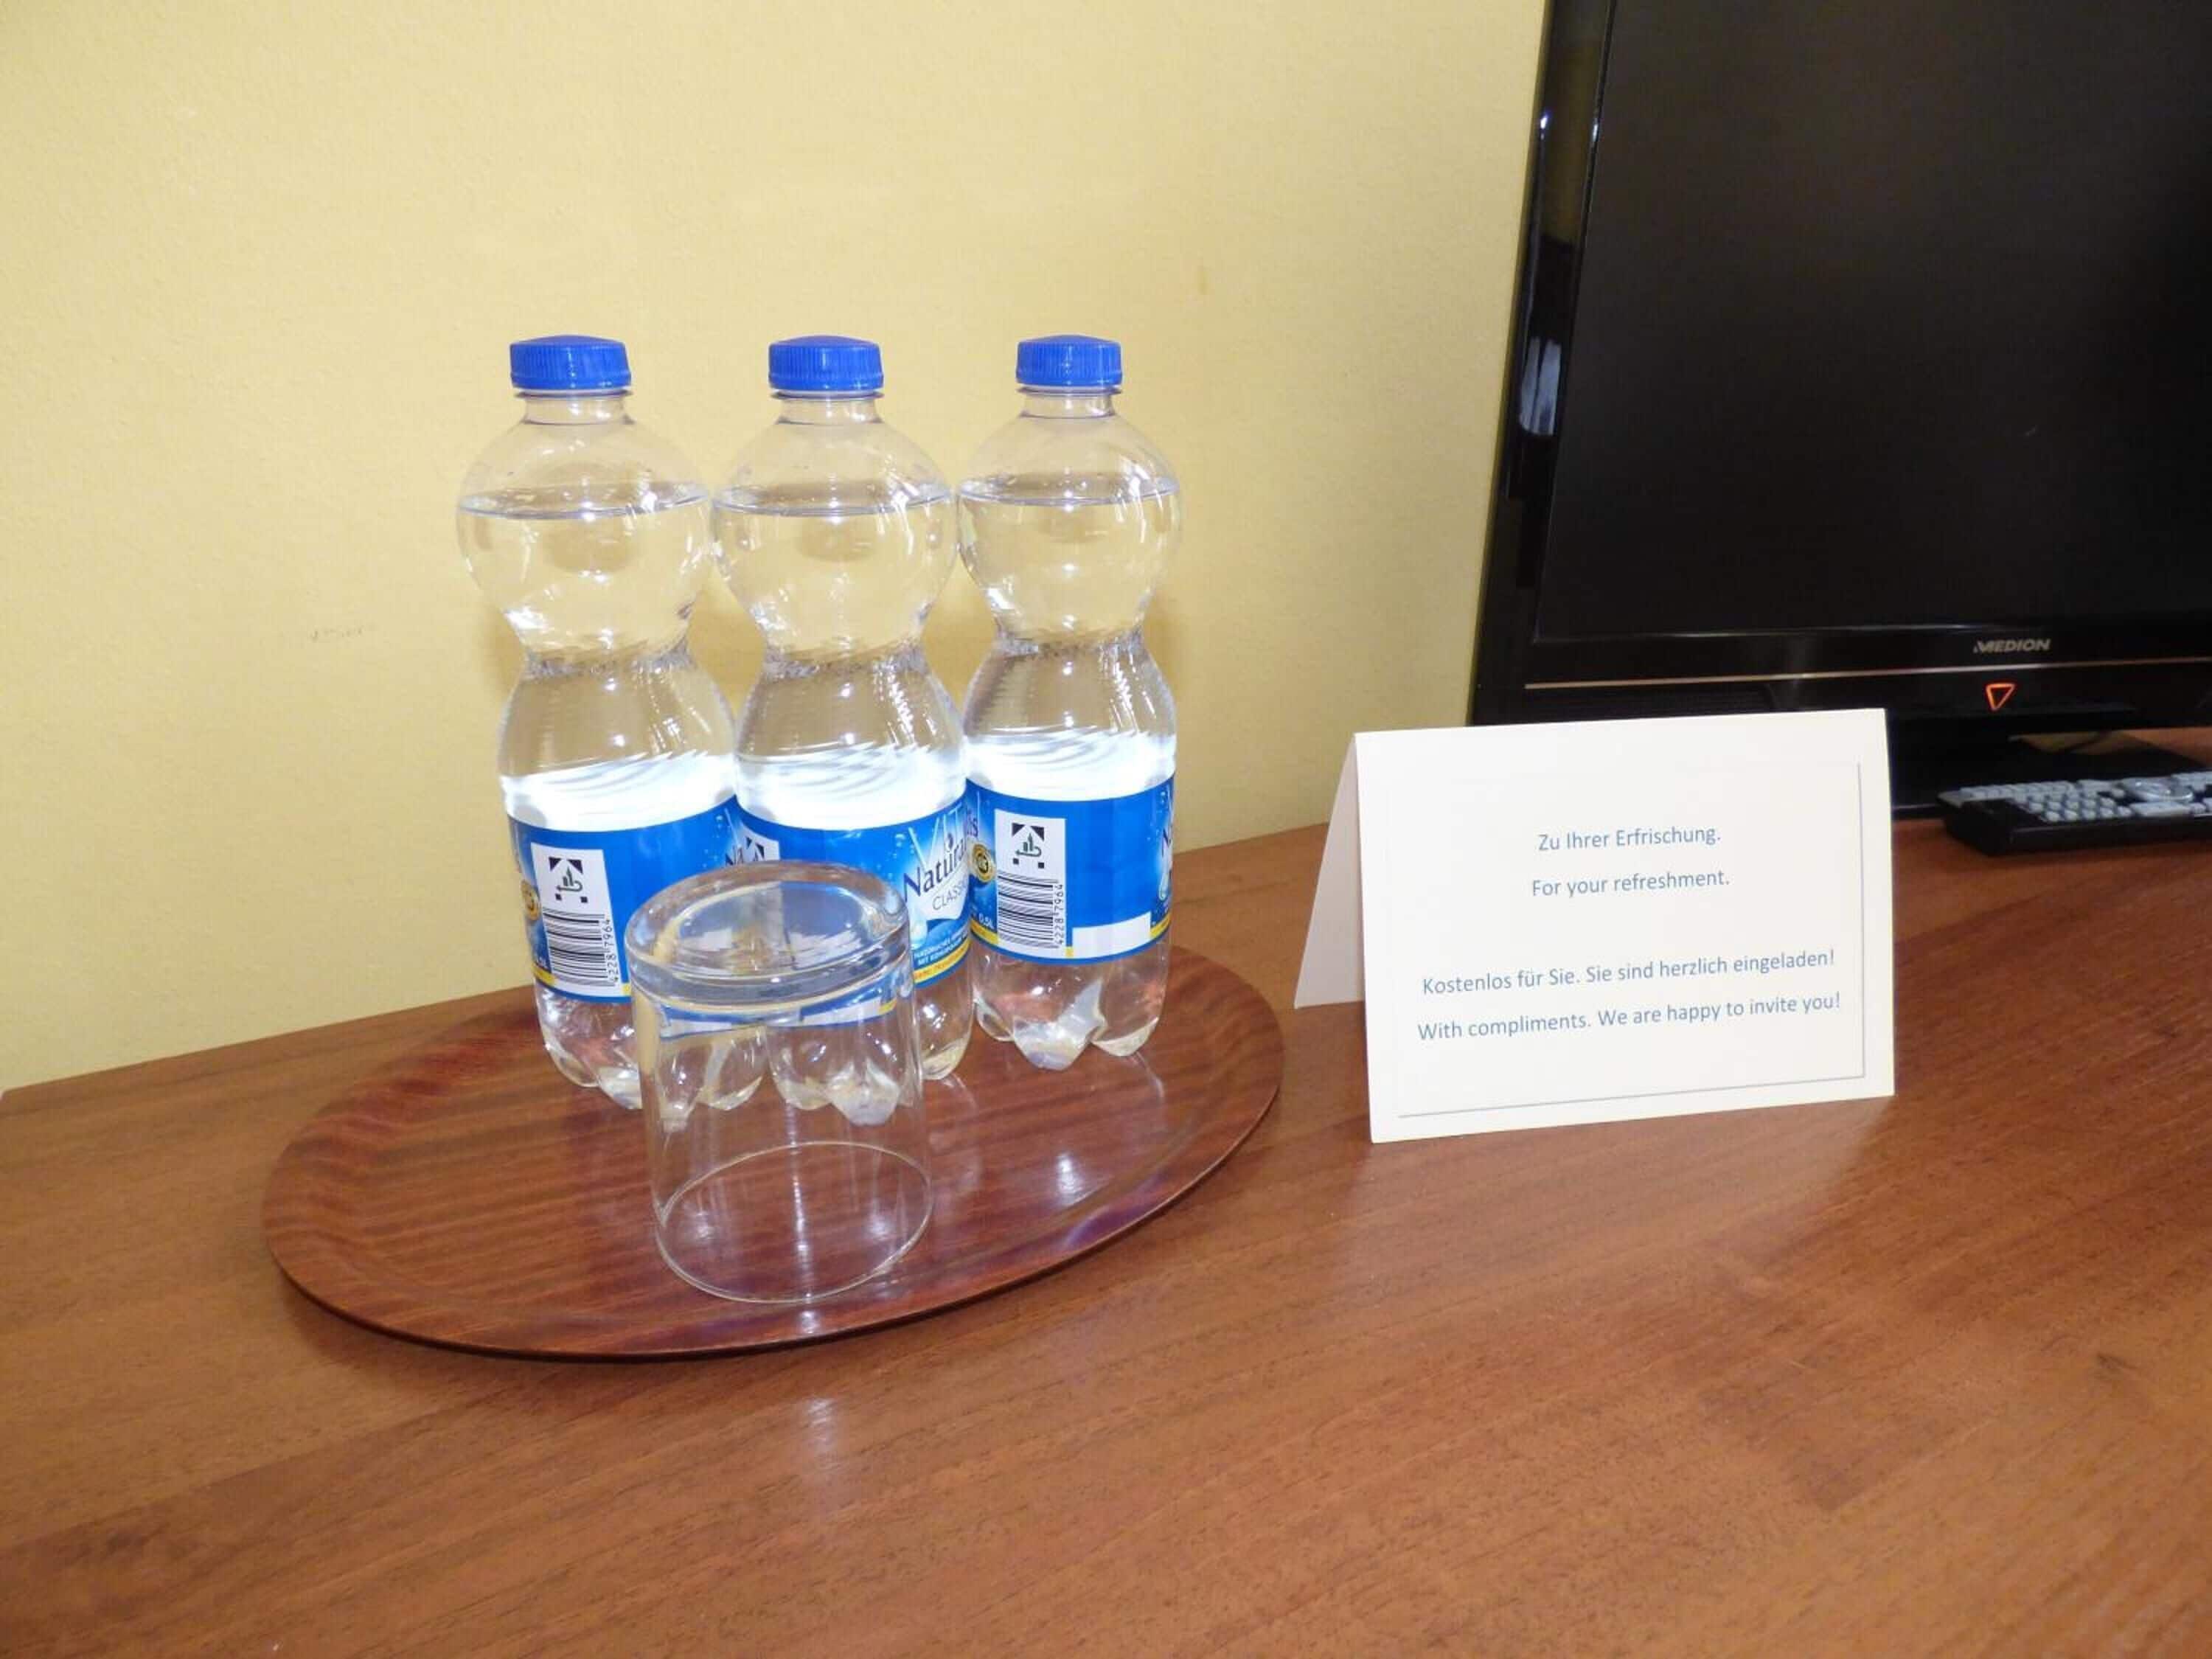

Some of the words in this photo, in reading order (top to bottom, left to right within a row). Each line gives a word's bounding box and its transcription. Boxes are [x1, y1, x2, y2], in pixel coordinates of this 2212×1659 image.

[1972, 638, 2051, 653] MEDION
[1538, 834, 1559, 851] Zu
[1567, 832, 1610, 849] Ihrer
[1616, 826, 1721, 846] Erfrischung.
[1532, 880, 1562, 897] For
[1566, 880, 1609, 899] your
[1614, 870, 1730, 891] refreshment.
[1422, 973, 1512, 995] Kostenlos
[1517, 970, 1544, 987] für
[1549, 968, 1580, 985] Sie.
[1587, 965, 1612, 982] Sie
[1618, 961, 1653, 981] sind
[1660, 956, 1727, 977] herzlich
[1733, 948, 1834, 973] eingeladen!
[1417, 1020, 1462, 1040] With
[1469, 1015, 1591, 1037] compliments.
[1599, 1010, 1627, 1026] We
[1633, 1009, 1661, 1024] are
[1667, 1004, 1721, 1024] happy
[1726, 1002, 1744, 1016] to
[1750, 997, 1797, 1015] invite
[1803, 991, 1840, 1015] you!
